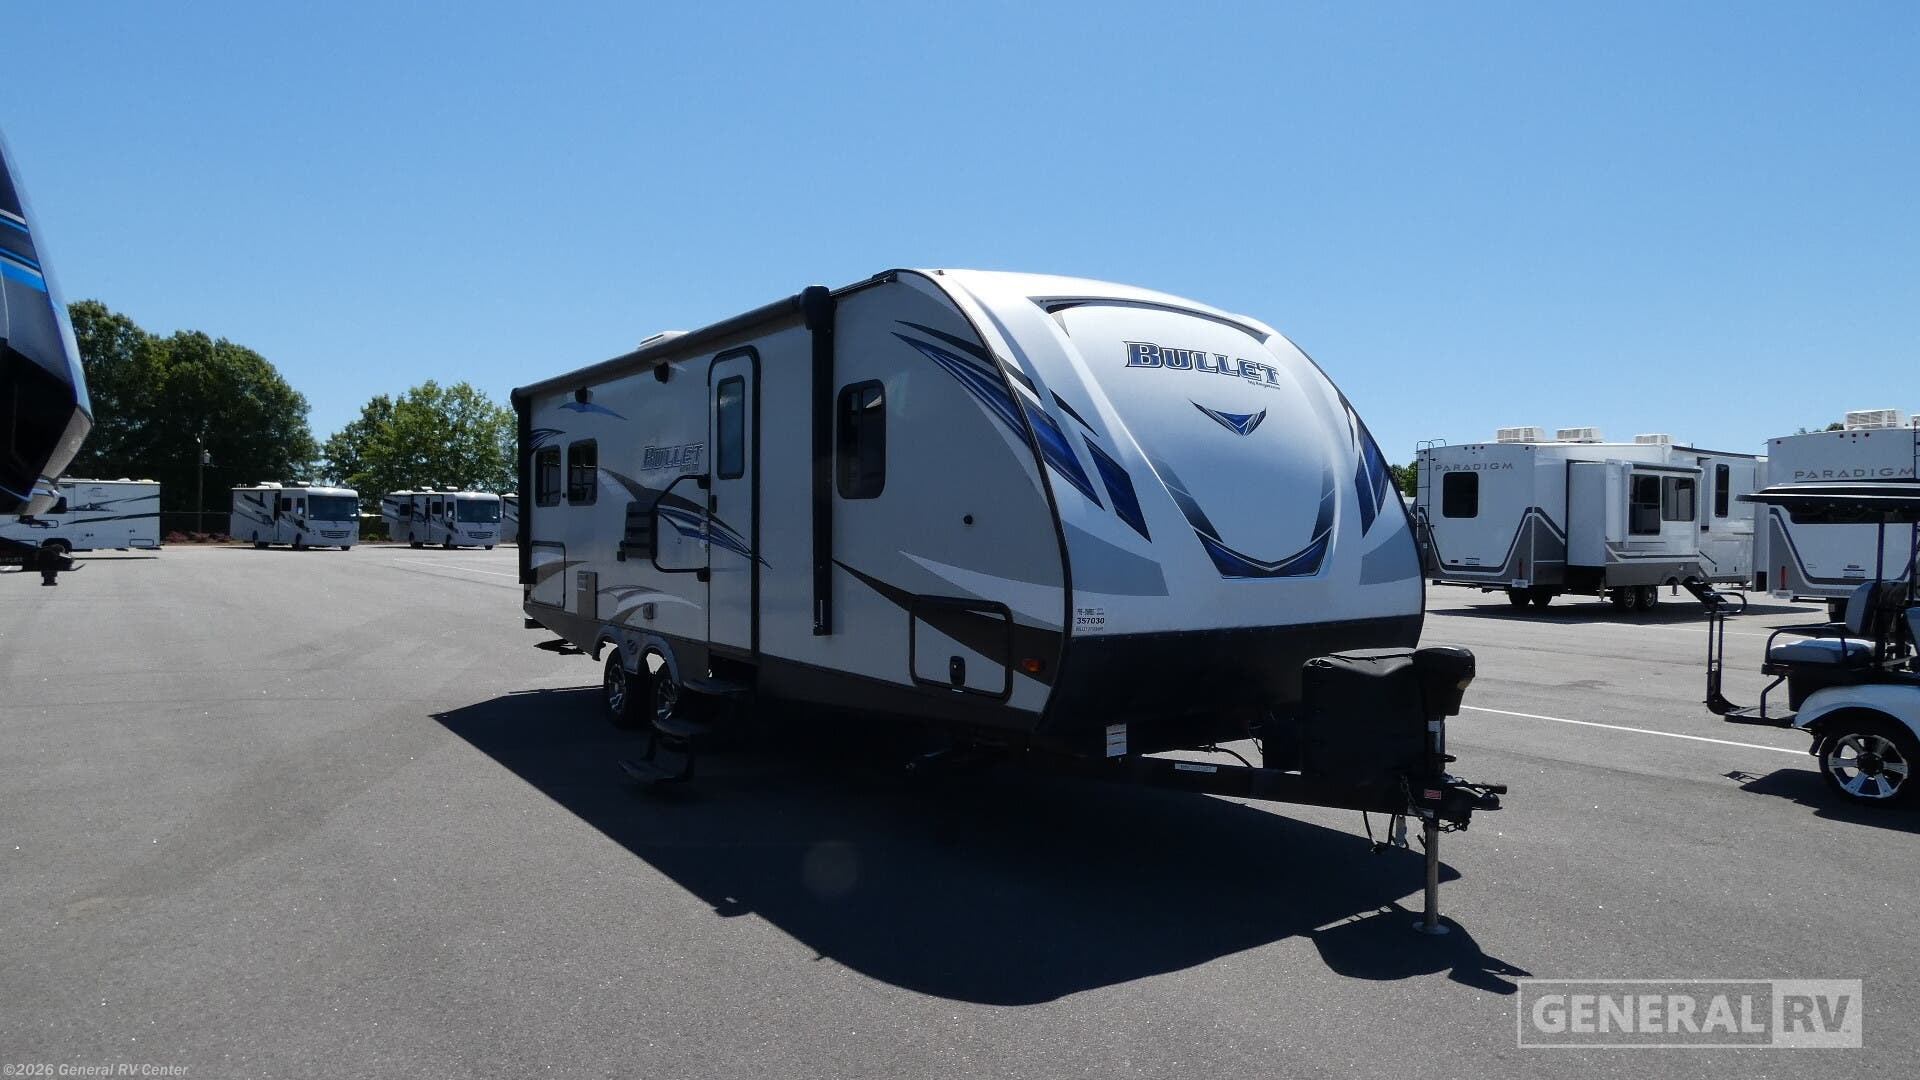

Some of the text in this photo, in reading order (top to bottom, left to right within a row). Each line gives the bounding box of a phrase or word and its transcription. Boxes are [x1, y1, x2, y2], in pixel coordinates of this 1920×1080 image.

[1122, 341, 1281, 386] BULLET
[641, 443, 704, 471] BULLET
[1435, 462, 1513, 472] PARADIGM
[1794, 467, 1915, 479] PARADIGM
[1076, 617, 1105, 625] 357030
